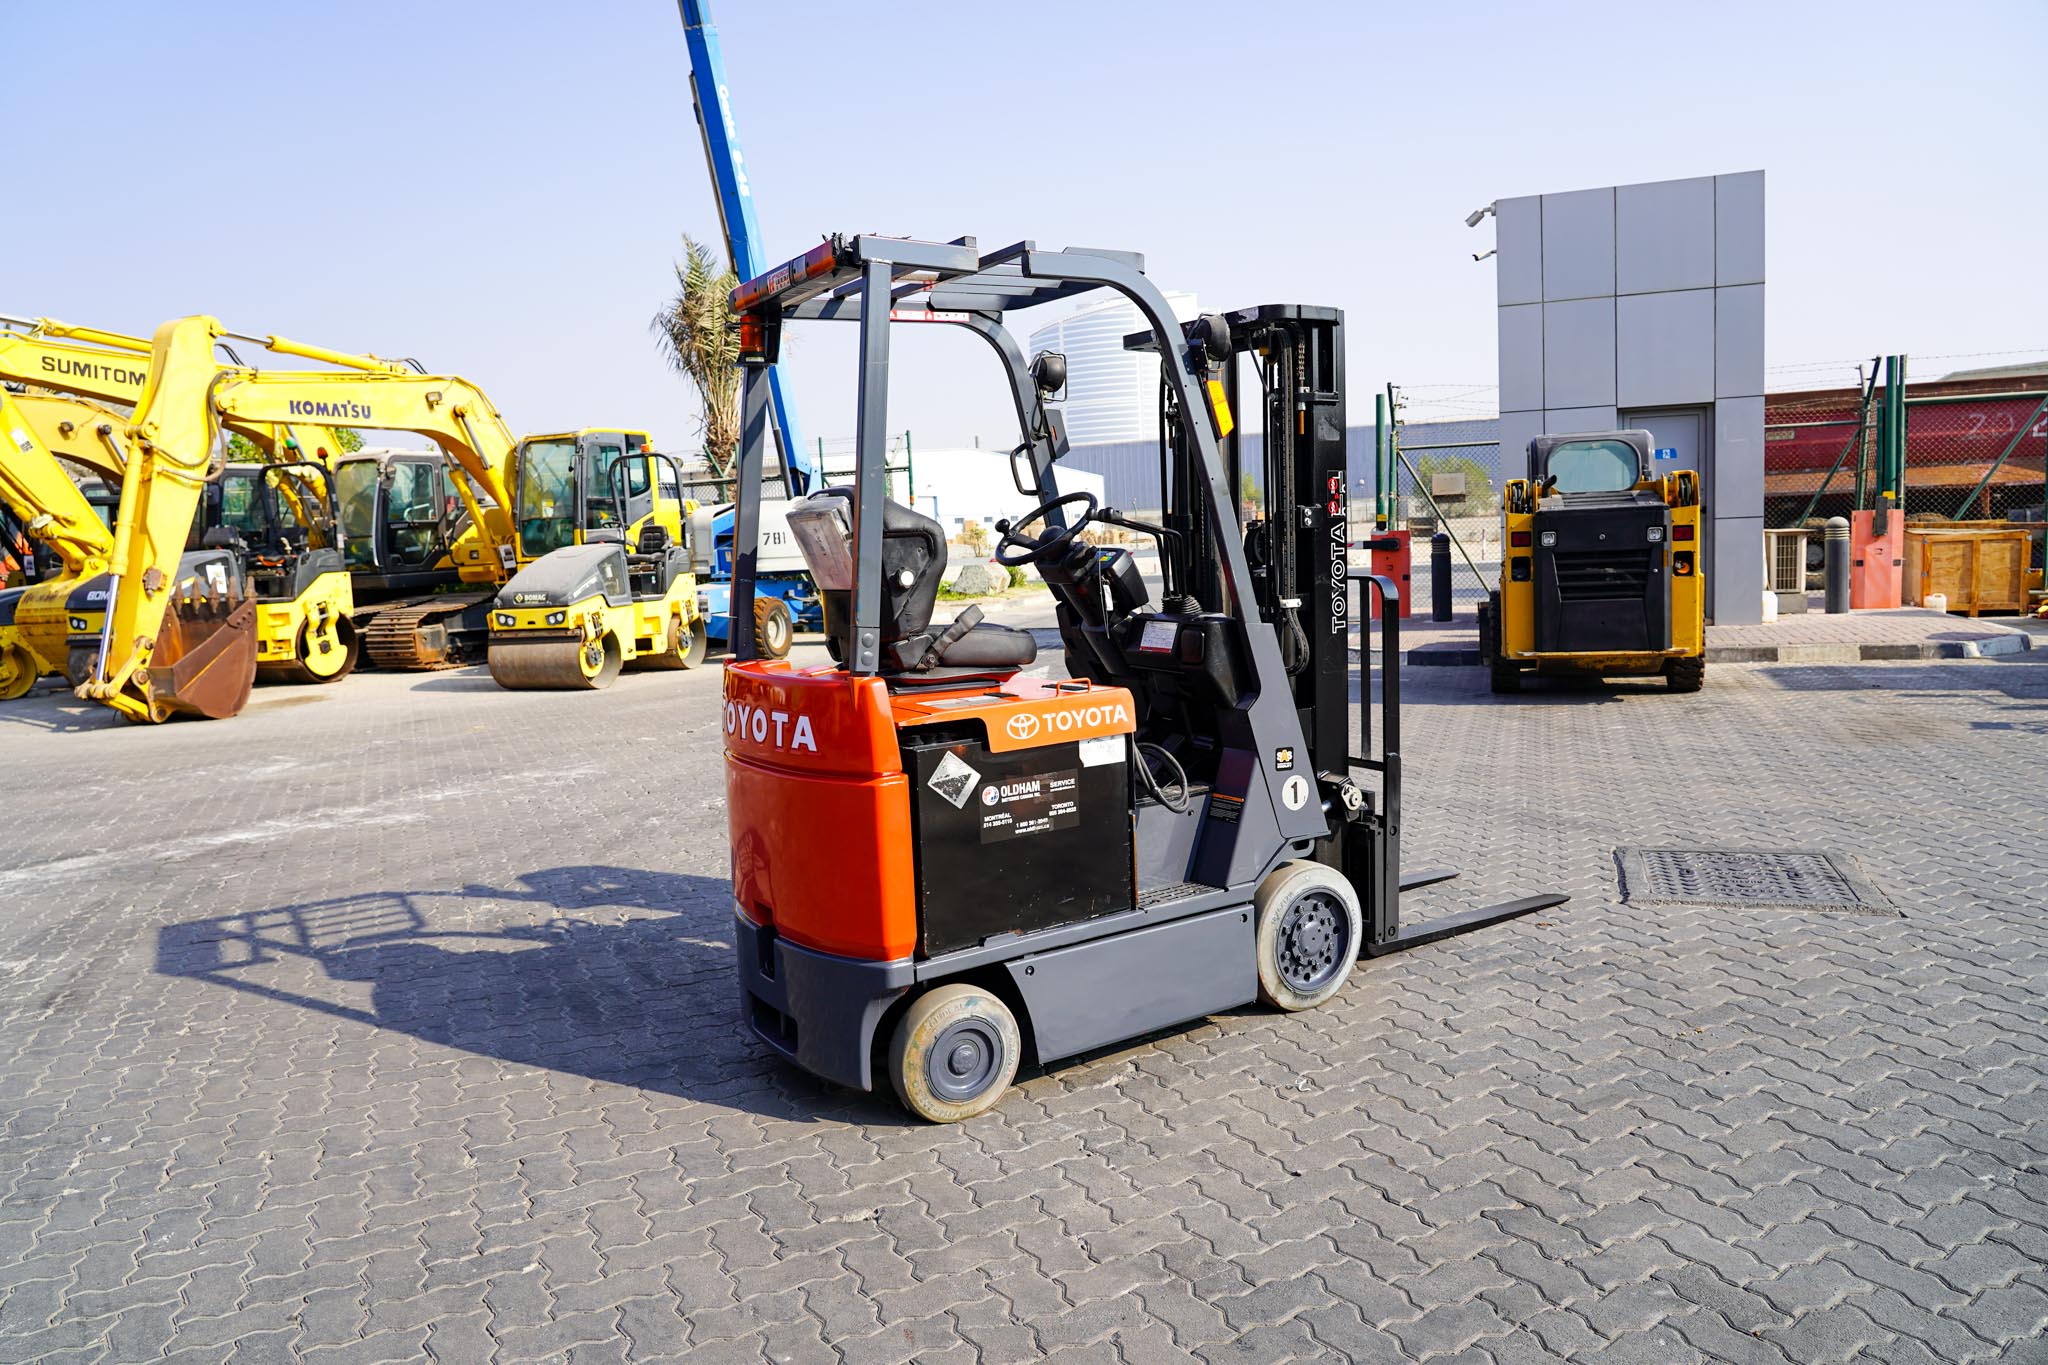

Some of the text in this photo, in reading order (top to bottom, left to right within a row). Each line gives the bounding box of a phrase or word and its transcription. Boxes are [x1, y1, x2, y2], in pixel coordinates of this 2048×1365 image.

[41, 356, 146, 386] SUMITOM
[289, 399, 371, 419] KOMATSU
[762, 532, 786, 546] 781
[1330, 521, 1346, 634] TOYOTA
[87, 591, 110, 601] BOM
[524, 593, 546, 601] BOMAG
[1042, 704, 1129, 733] TOYOTA
[723, 702, 817, 752] OYOTA
[1276, 749, 1293, 762] SAS
[1000, 780, 1041, 797] OLDHAM
[1050, 778, 1075, 788] SERVICE
[1290, 781, 1298, 804] 1
[1051, 801, 1074, 810] TORONTO
[984, 812, 1011, 822] MONTRÉAL
